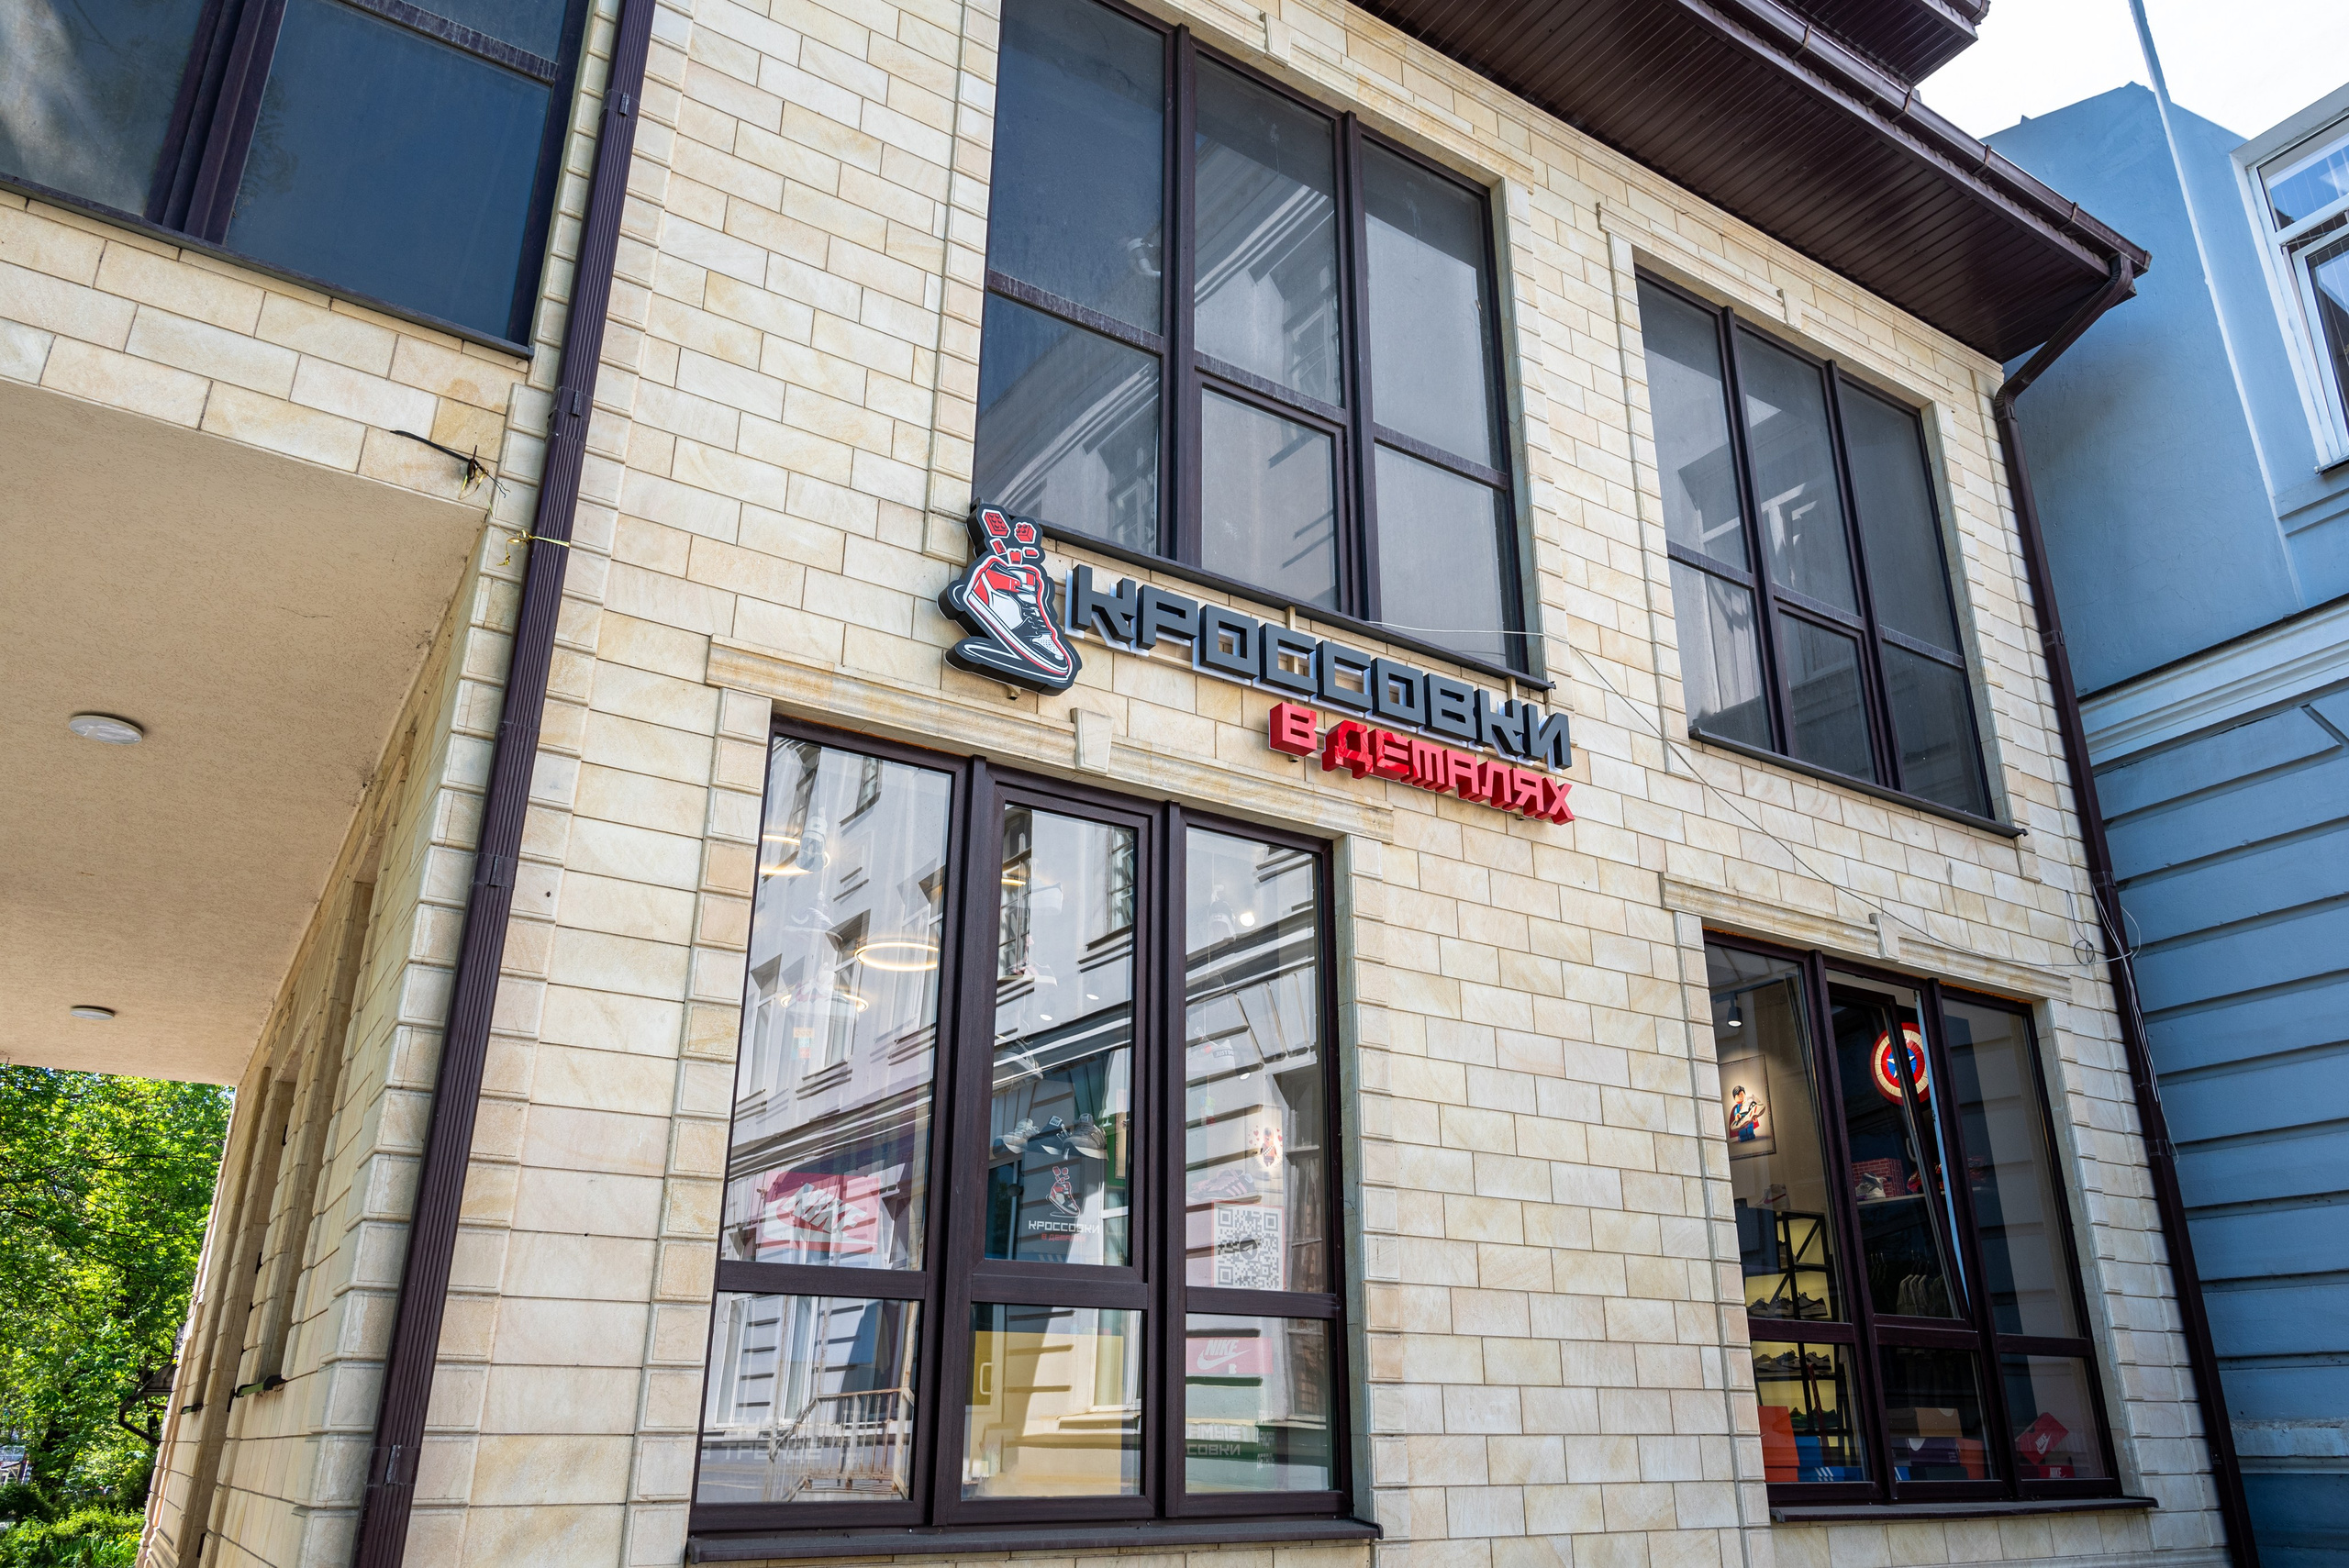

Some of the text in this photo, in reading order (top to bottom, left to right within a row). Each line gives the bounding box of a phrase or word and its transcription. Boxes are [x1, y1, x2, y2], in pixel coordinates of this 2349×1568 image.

[1067, 563, 1571, 770] КРОССОВКИ
[1270, 702, 1576, 826] В ДЕТАЛЯХ
[1028, 1219, 1100, 1234] КРОССОВКИ
[1205, 1339, 1239, 1356] NIKE
[2035, 1432, 2048, 1450] NIKE
